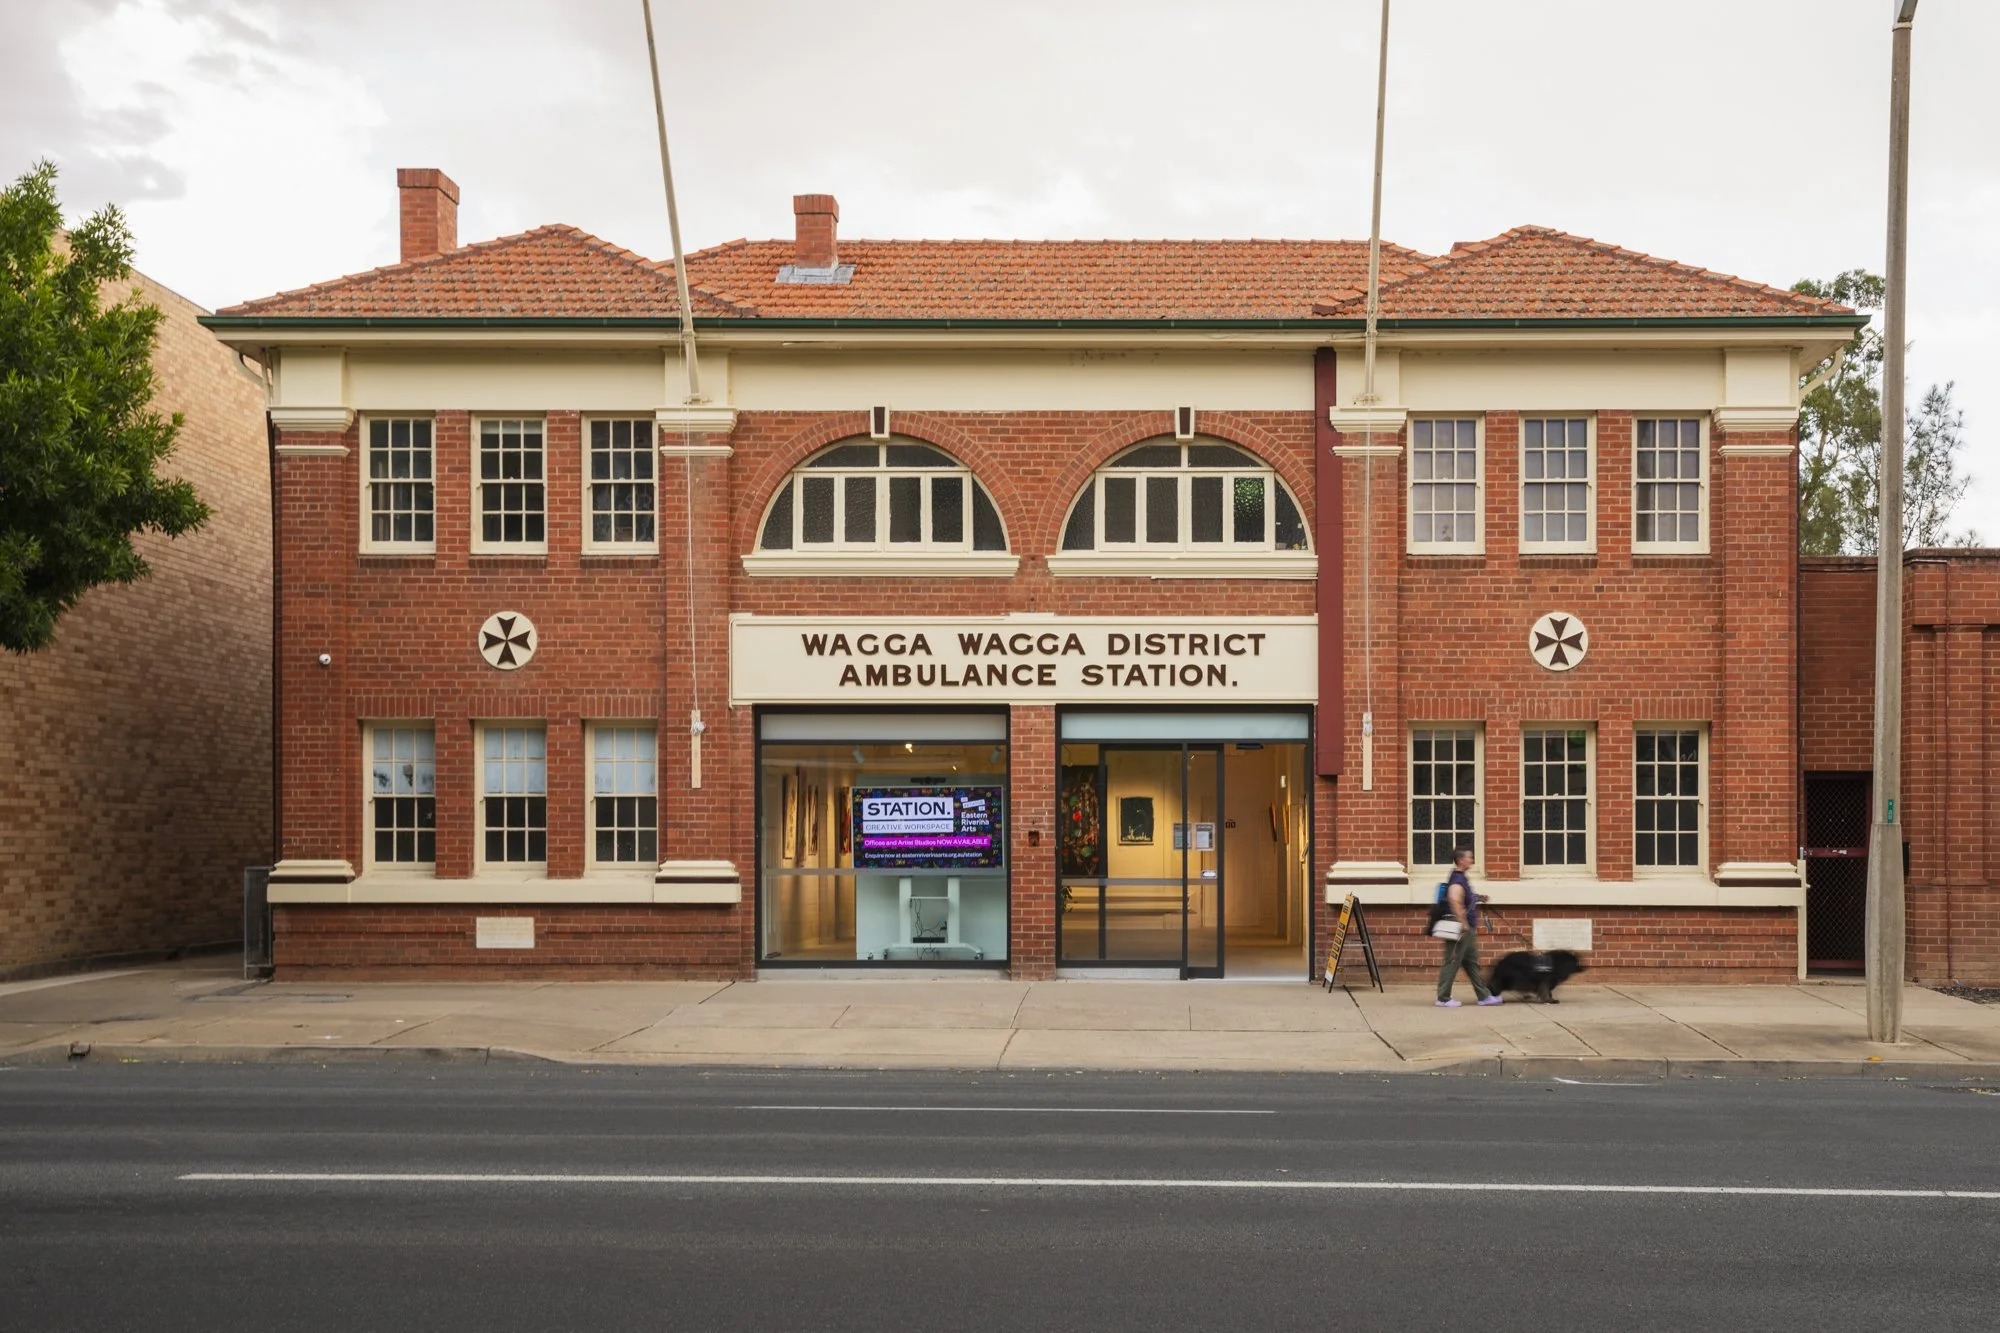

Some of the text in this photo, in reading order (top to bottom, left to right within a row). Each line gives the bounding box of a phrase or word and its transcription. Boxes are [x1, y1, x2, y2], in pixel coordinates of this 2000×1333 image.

[802, 633, 1265, 656] WAGGA WAGGA DISTRICT
[839, 663, 1238, 687] AMBULANCE STATION.
[867, 801, 951, 816] STATION.
[865, 823, 901, 831] CREATIVE
